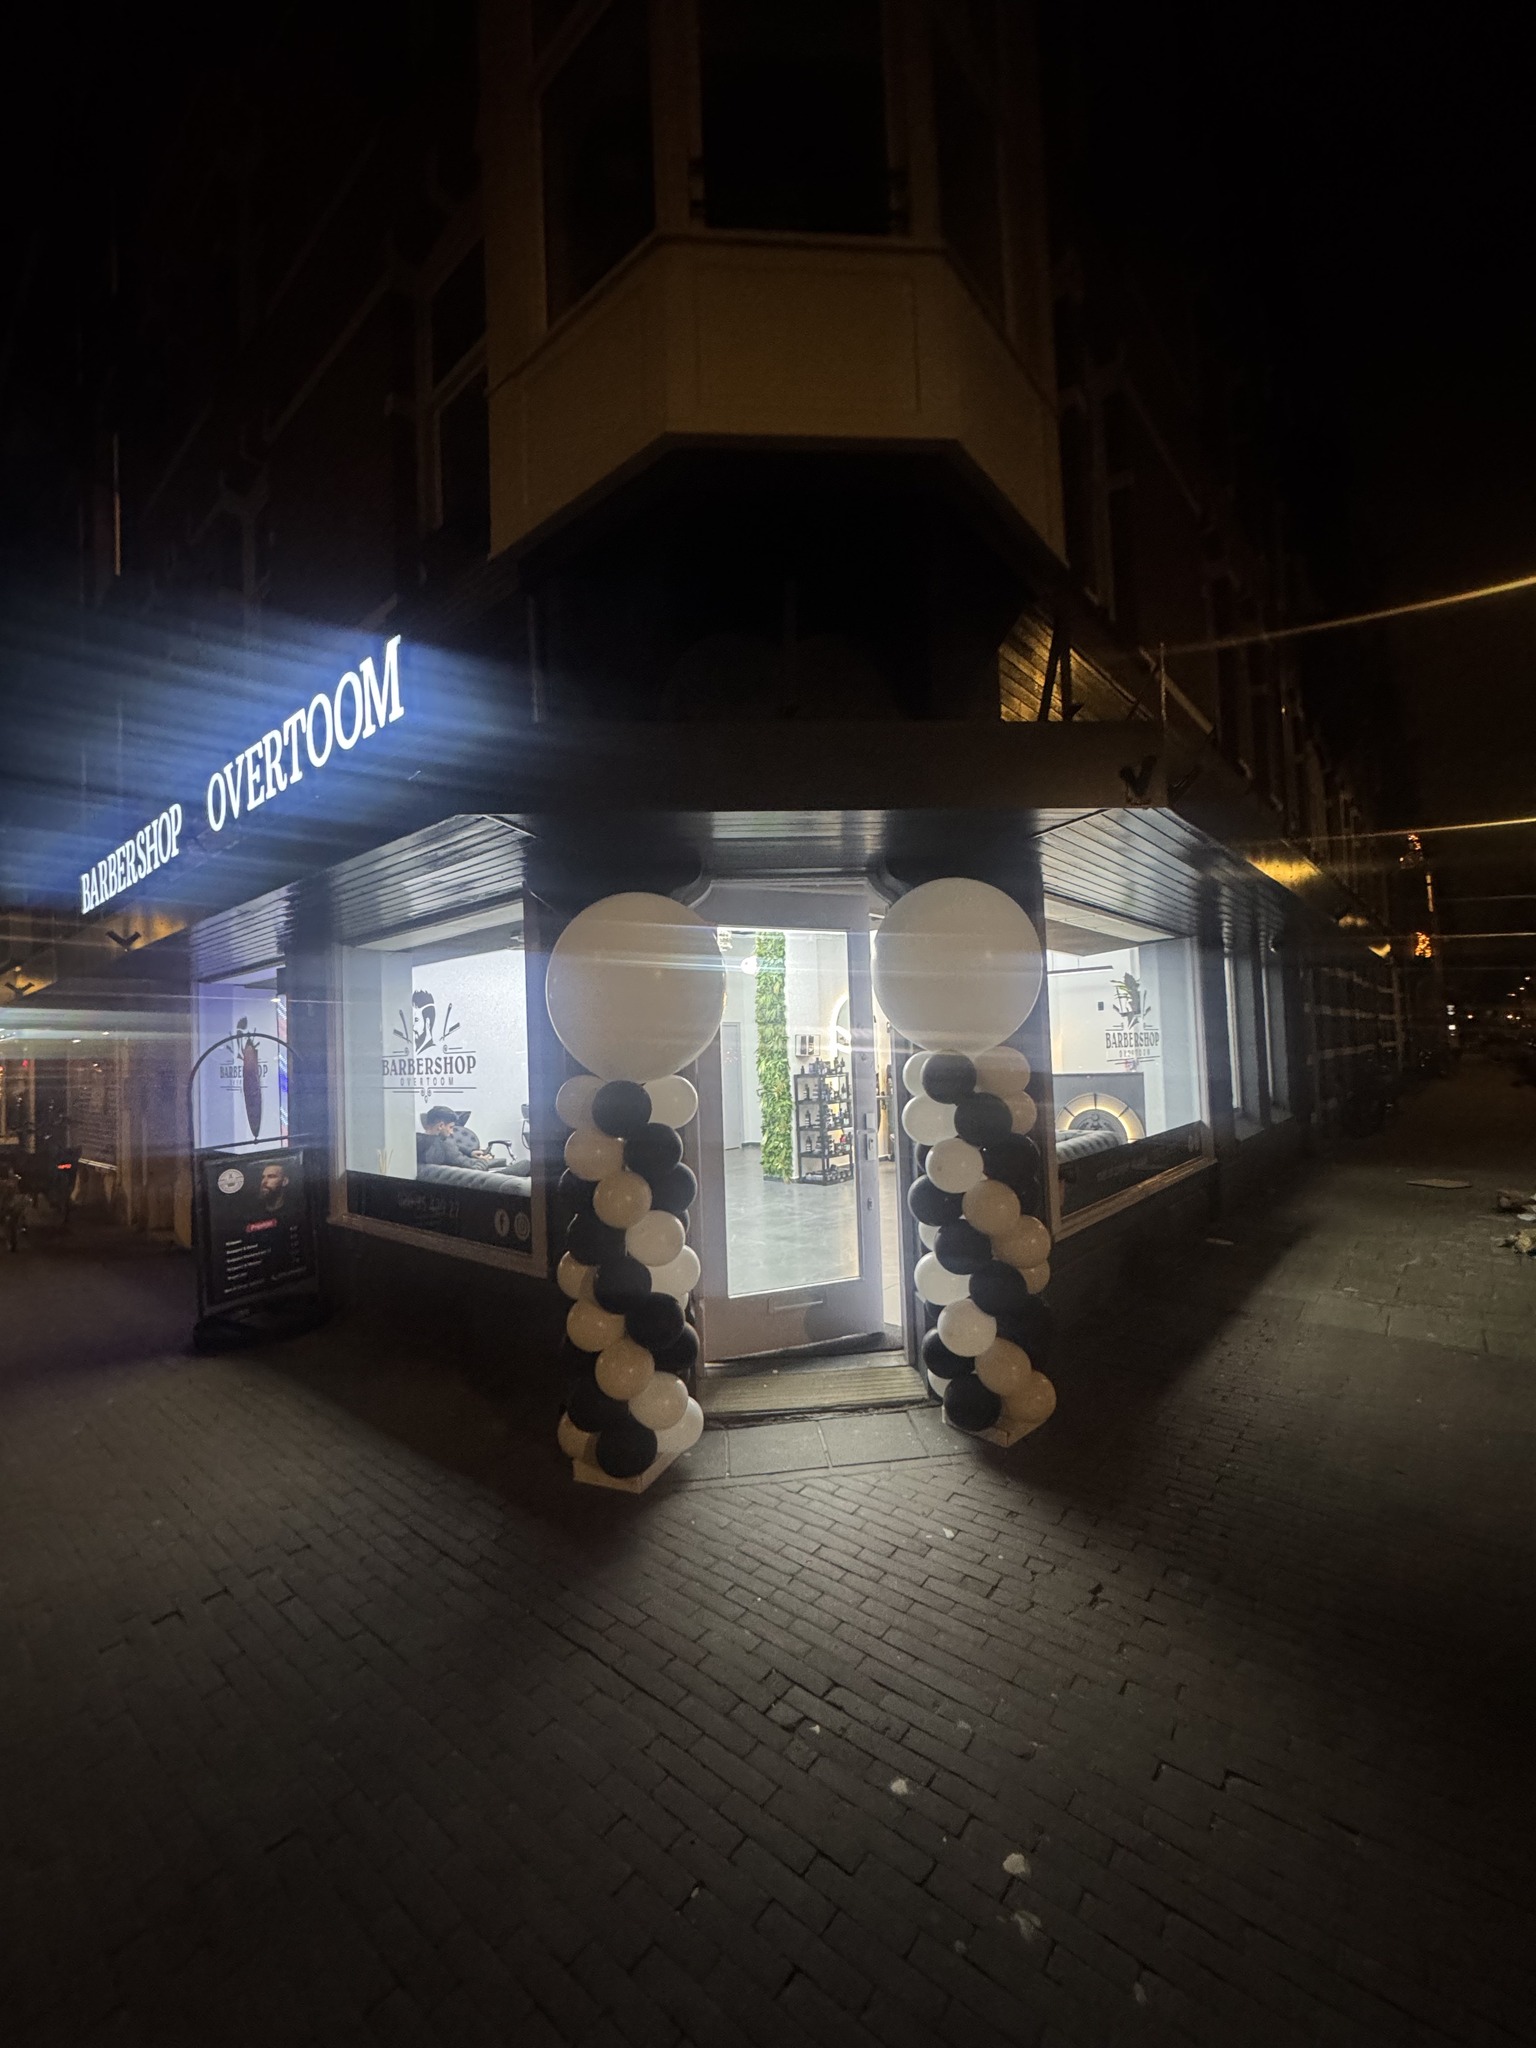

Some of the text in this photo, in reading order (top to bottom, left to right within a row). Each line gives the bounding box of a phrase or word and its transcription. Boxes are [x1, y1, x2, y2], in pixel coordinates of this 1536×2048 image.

[81, 634, 405, 915] BARBERSHOP OVERTOOM
[1105, 1032, 1160, 1048] BARBERSHOP
[382, 1055, 476, 1076] BARBERSHOP
[400, 1077, 454, 1086] OVERTOOM
